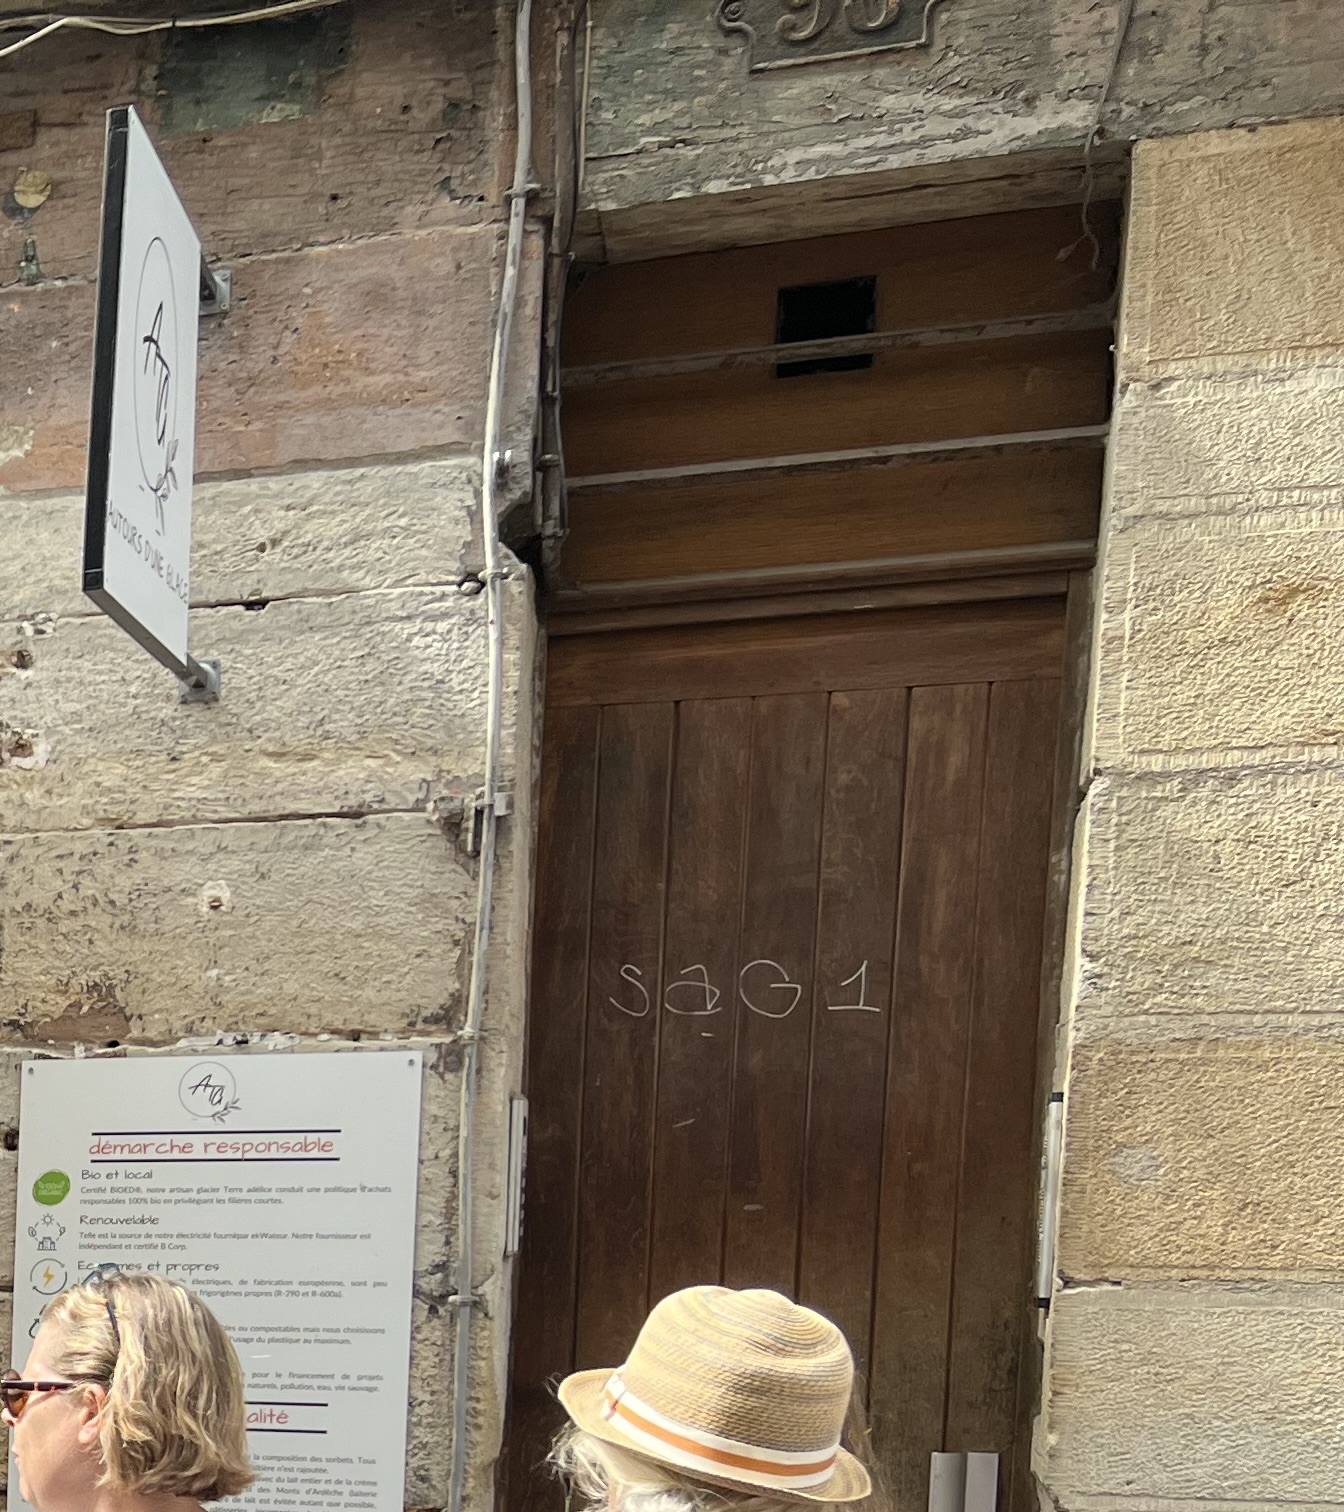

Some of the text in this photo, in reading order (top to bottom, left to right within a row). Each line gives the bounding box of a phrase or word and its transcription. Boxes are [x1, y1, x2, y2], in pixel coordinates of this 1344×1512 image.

[88, 1137, 335, 1160] démarche responsable
[81, 1169, 153, 1181] Bio et local
[79, 1214, 160, 1226] Renouvelable
[147, 1260, 161, 1270] et
[165, 1261, 220, 1275] propres
[249, 1325, 301, 1334] compostables
[357, 1457, 376, 1465] Tous
